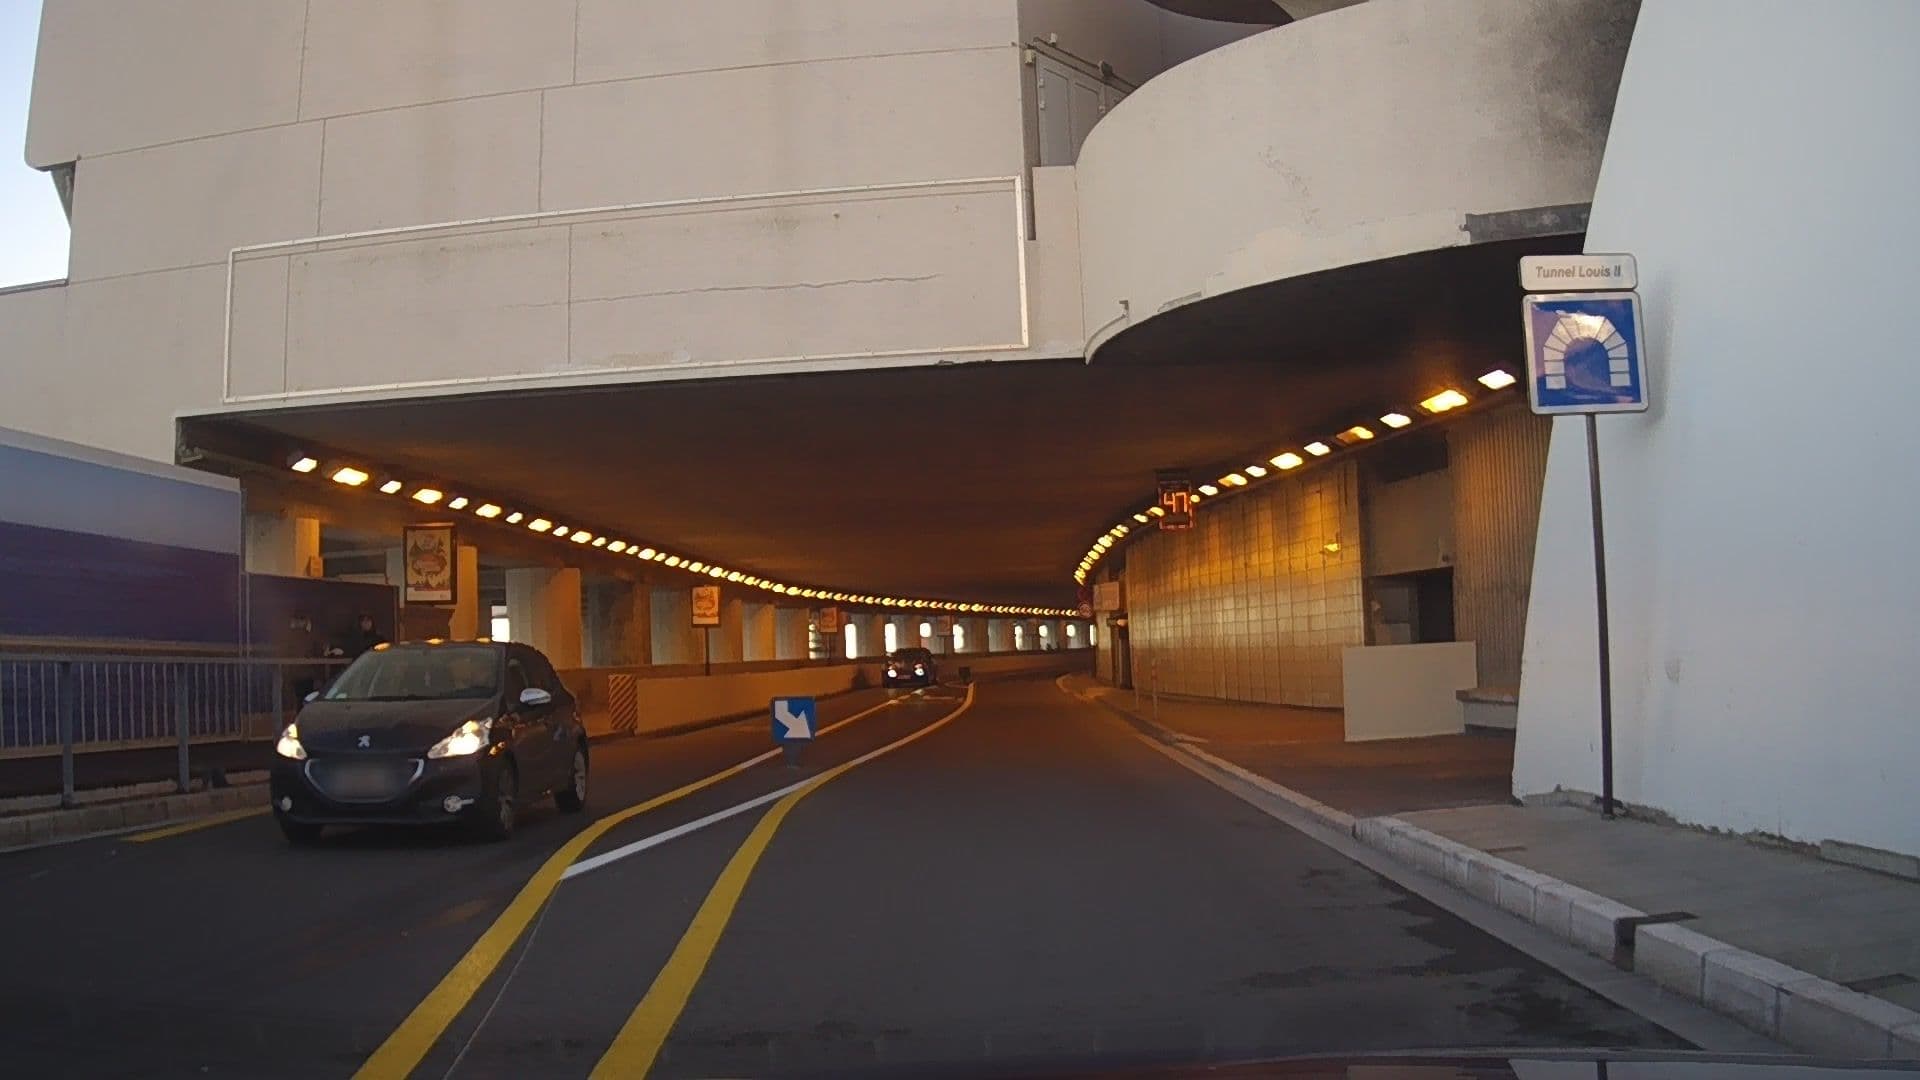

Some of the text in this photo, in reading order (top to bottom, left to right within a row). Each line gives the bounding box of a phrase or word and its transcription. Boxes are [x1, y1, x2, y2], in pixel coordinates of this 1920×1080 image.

[1536, 265, 1621, 278] Tunnel Louis II
[1163, 492, 1188, 513] 47
